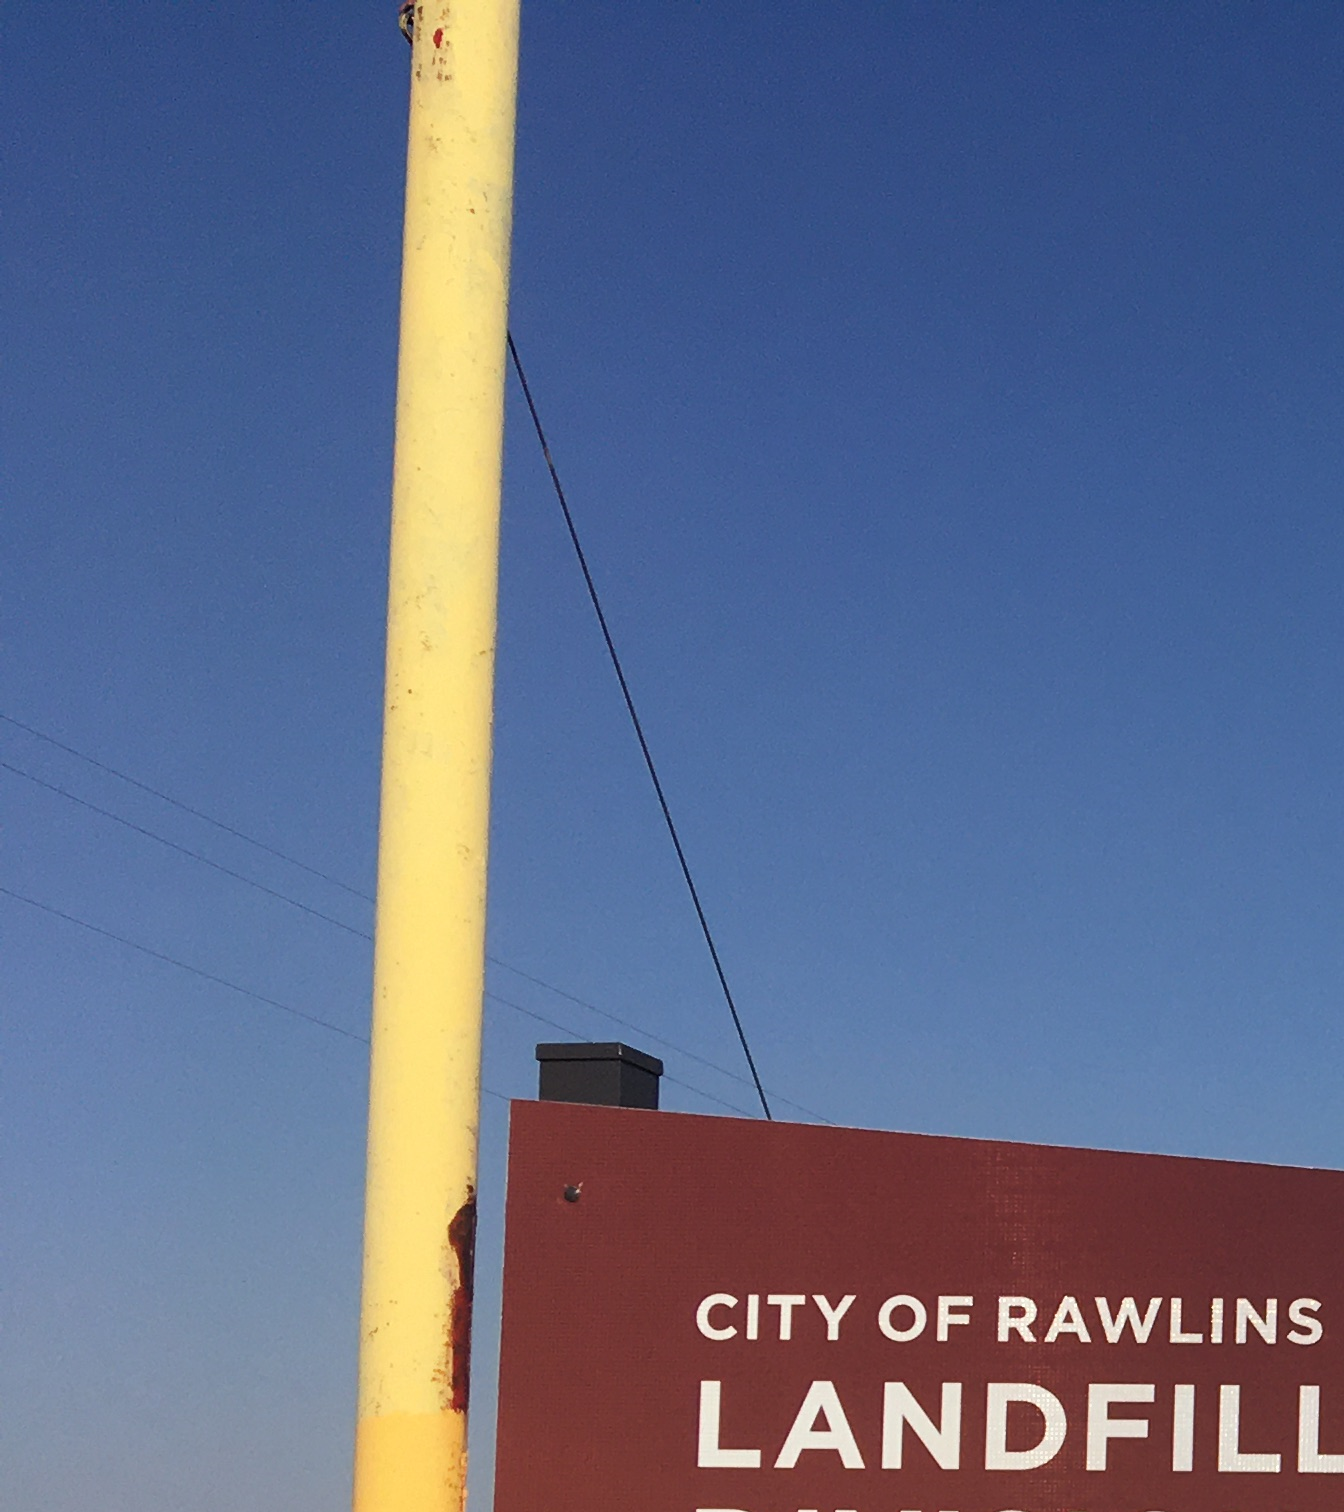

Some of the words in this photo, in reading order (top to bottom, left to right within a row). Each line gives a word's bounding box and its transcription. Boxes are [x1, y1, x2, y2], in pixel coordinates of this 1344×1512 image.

[695, 1292, 858, 1342] CITY
[877, 1293, 975, 1343] OF
[996, 1294, 1324, 1346] RAWLINS
